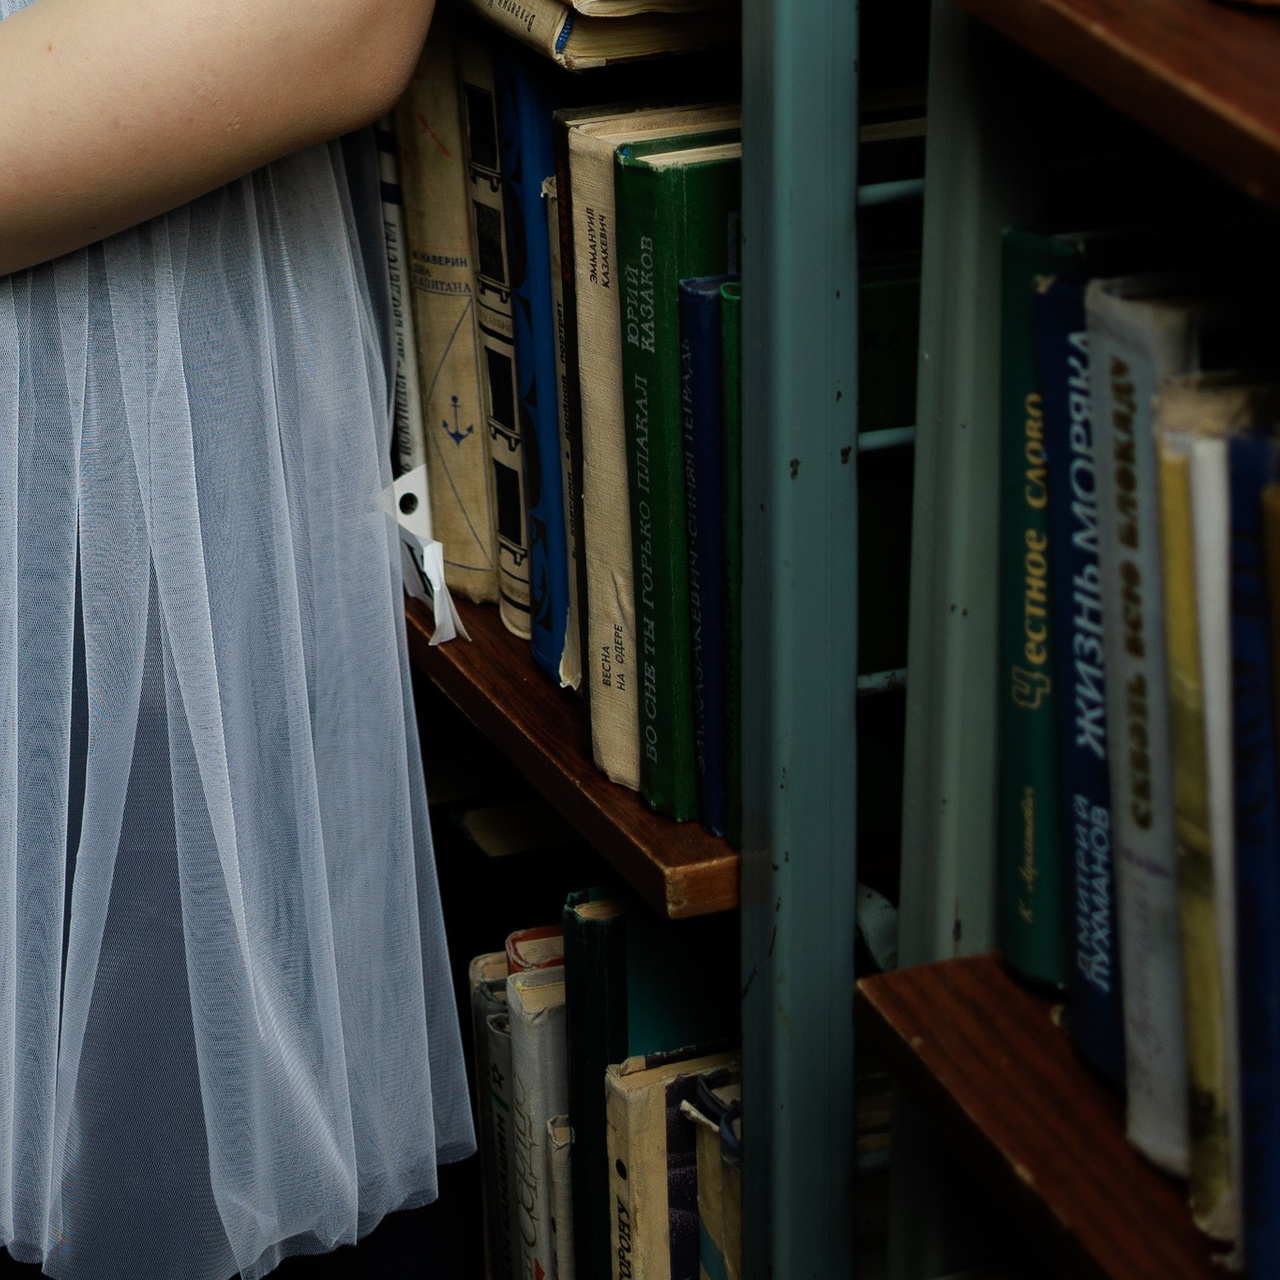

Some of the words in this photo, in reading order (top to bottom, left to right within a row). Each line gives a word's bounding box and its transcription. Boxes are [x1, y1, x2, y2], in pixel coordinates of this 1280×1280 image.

[585, 208, 599, 285] ЭММАНУИЛ
[597, 214, 611, 289] КАЗАКЕВИЧ
[624, 265, 641, 348] ЮРИЙ
[638, 235, 656, 353] КАЗАКОВ
[634, 373, 652, 493] ПЛАКАЛ
[637, 501, 655, 611] ГОРЬКО
[612, 624, 625, 665] ОДЕРЕ
[641, 613, 656, 656] ТЫ
[1119, 559, 1145, 658] ВСЮ
[601, 646, 612, 687] ВЕСНА
[616, 674, 626, 692] НА
[642, 658, 658, 719] СНЕ
[1068, 563, 1106, 762] ЖИЗНЬ
[643, 724, 659, 765] ВО
[1125, 674, 1152, 831] СКВОЗЬ
[1071, 793, 1093, 981] ДМИТРИЙ
[1088, 805, 1111, 995] ЛУХМАНОВ
